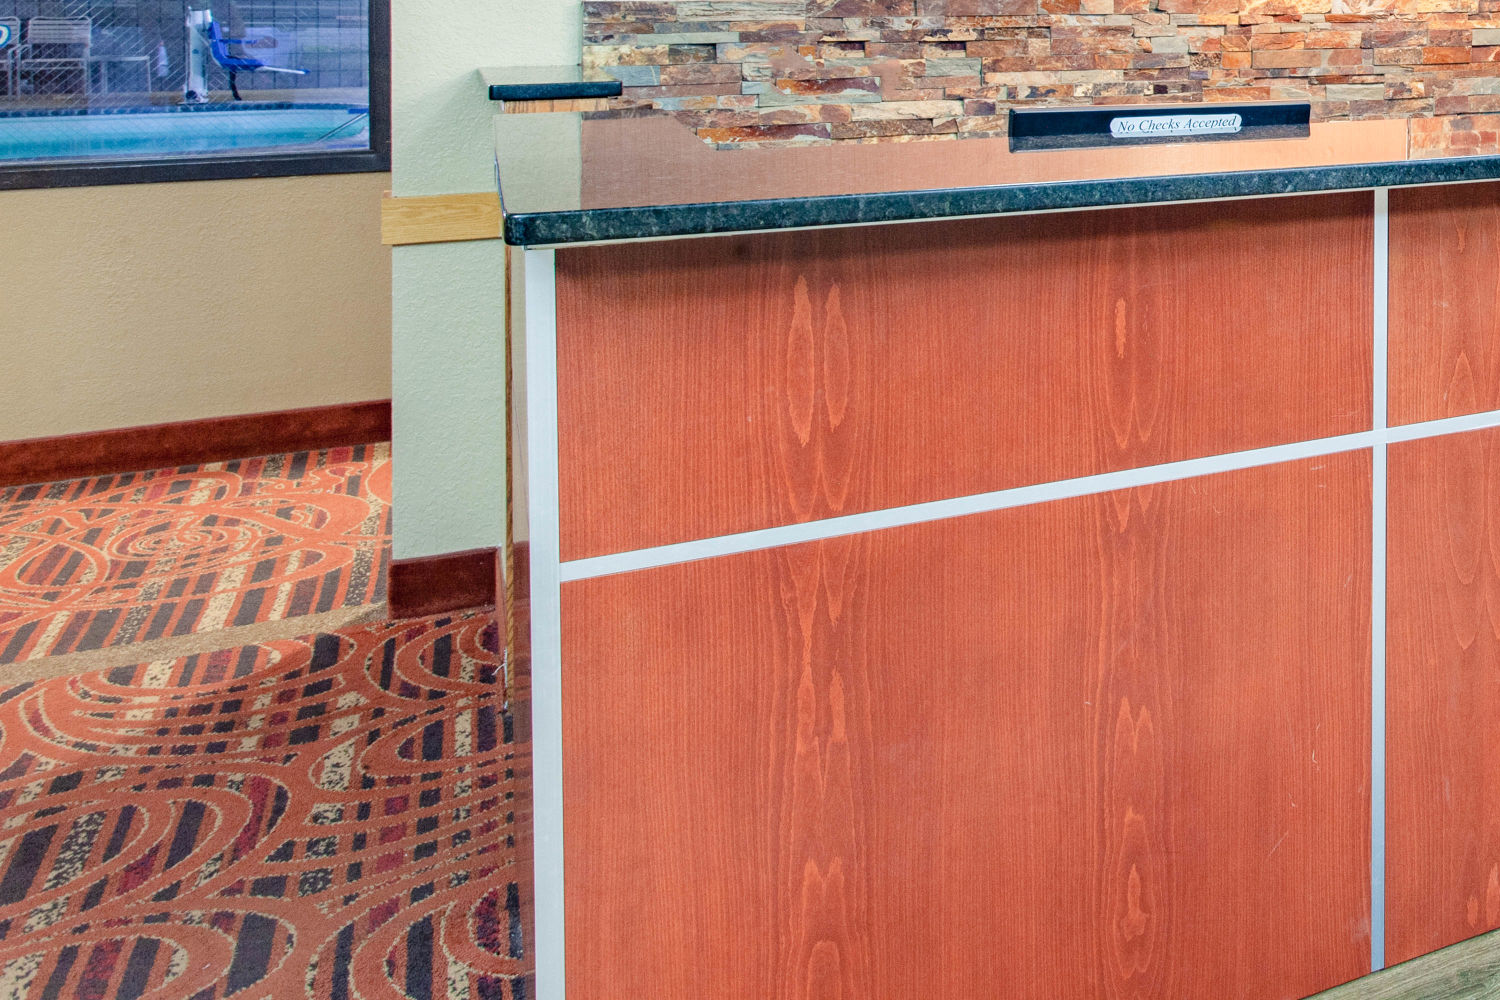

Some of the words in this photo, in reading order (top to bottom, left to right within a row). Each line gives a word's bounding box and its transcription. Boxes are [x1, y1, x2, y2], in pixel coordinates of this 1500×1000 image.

[1118, 121, 1135, 132] No
[1139, 119, 1181, 131] Checks
[1184, 115, 1237, 129] Accepted
